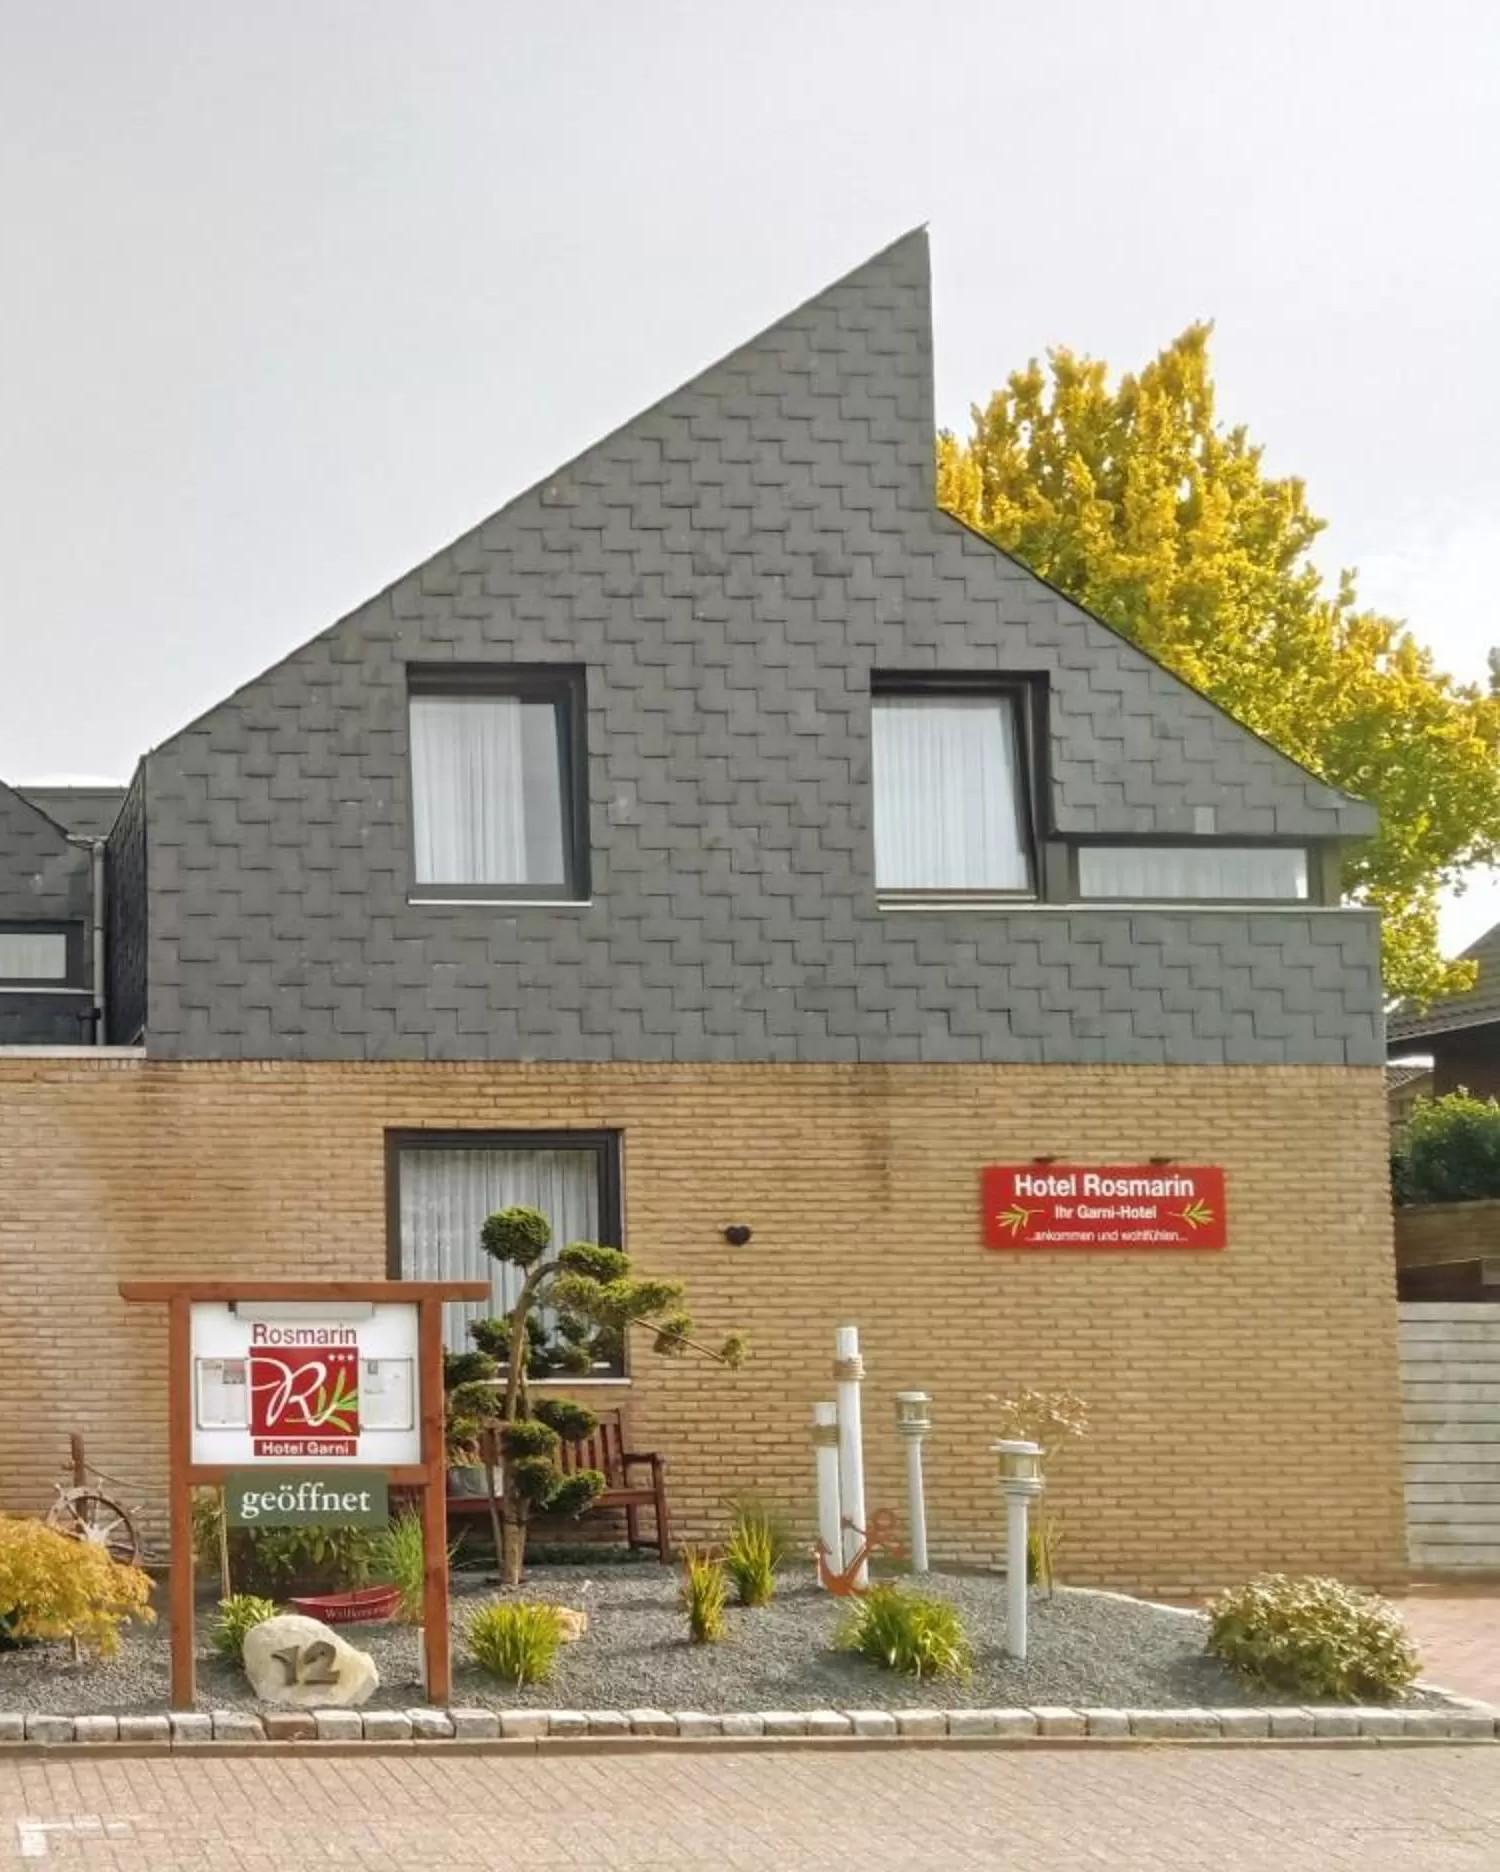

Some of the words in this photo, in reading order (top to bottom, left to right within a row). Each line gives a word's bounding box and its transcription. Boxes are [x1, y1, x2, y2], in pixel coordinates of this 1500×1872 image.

[1014, 1174, 1077, 1197] Hotel
[1083, 1174, 1194, 1197] Rosmarin
[1055, 1205, 1073, 1219] Ihr
[1076, 1204, 1156, 1219] Garni-Hotel
[1097, 1229, 1118, 1241] und
[252, 1323, 357, 1345] Rosmarin
[262, 1442, 304, 1455] Hotel
[307, 1442, 349, 1455] Garni
[240, 1482, 371, 1519] geöffnet
[270, 1641, 340, 1686] 12
